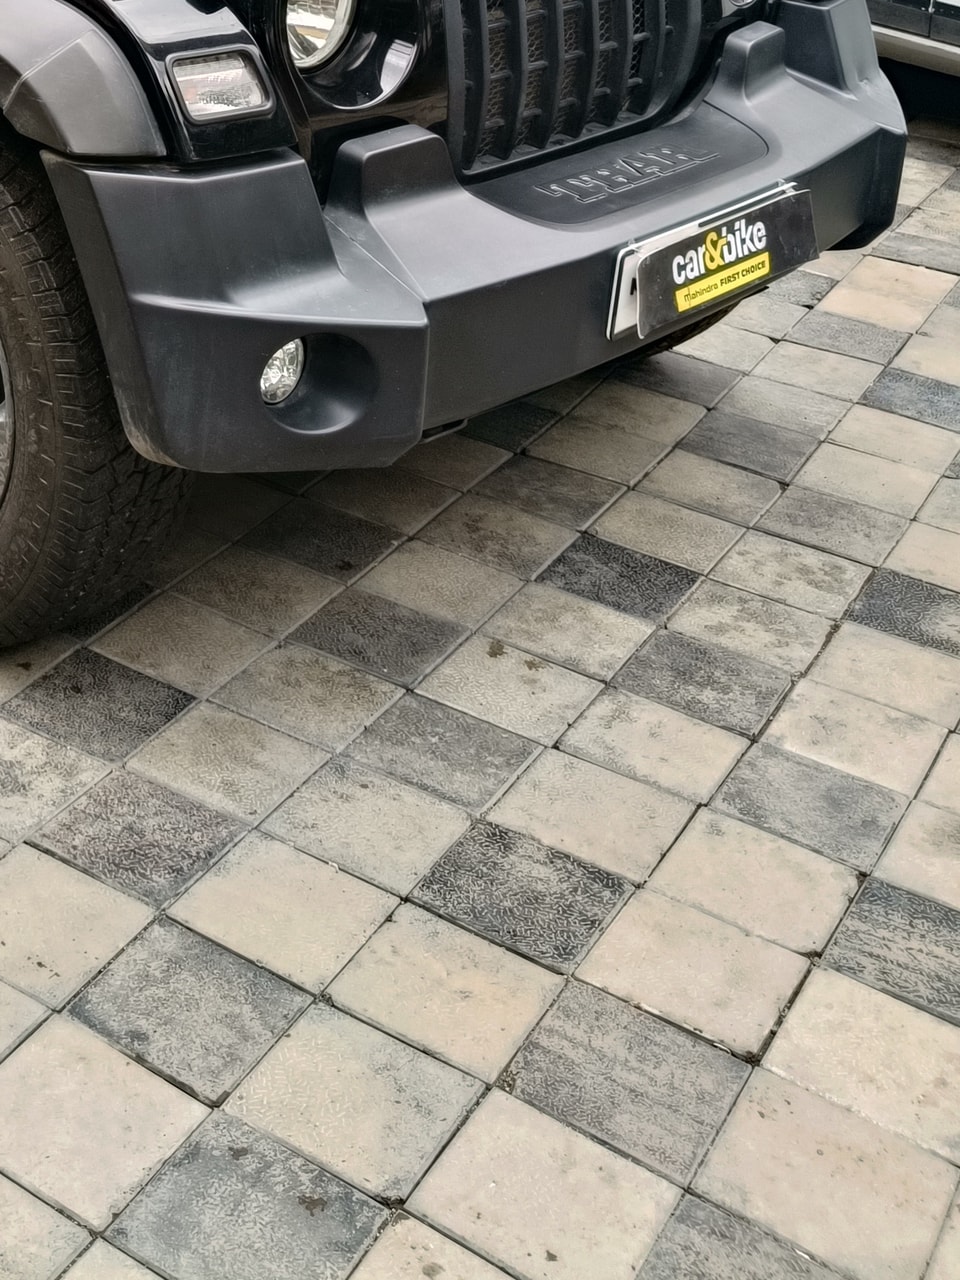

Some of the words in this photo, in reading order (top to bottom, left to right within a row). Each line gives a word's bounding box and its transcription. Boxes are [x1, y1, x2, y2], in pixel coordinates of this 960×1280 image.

[533, 147, 721, 204] THAR
[672, 219, 768, 285] car&bike
[684, 282, 719, 302] Mahindra
[720, 271, 741, 287] FIRST
[741, 260, 766, 278] CHOICE
